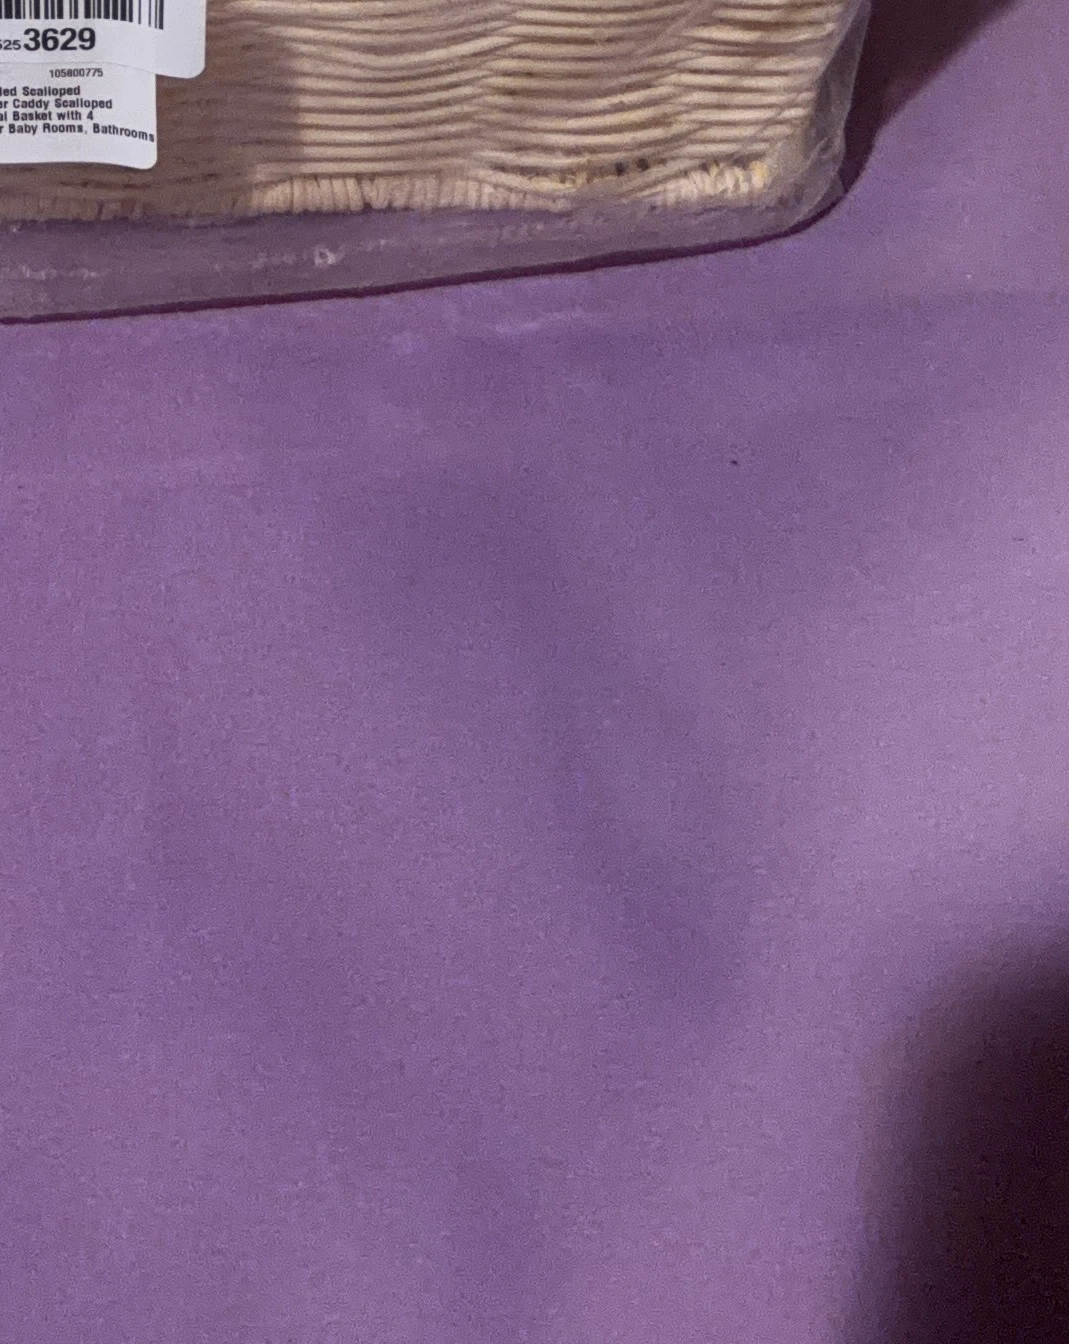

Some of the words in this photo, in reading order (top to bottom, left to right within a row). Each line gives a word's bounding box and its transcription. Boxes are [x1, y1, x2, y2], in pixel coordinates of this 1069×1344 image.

[22, 85, 81, 97] Scalloped
[12, 98, 50, 110] Caddy
[54, 97, 113, 110] Scalloped
[12, 110, 52, 121] Basket
[57, 110, 82, 121] with
[86, 110, 94, 121] 4
[8, 122, 38, 135] Baby
[92, 122, 155, 143] Bathrooms
